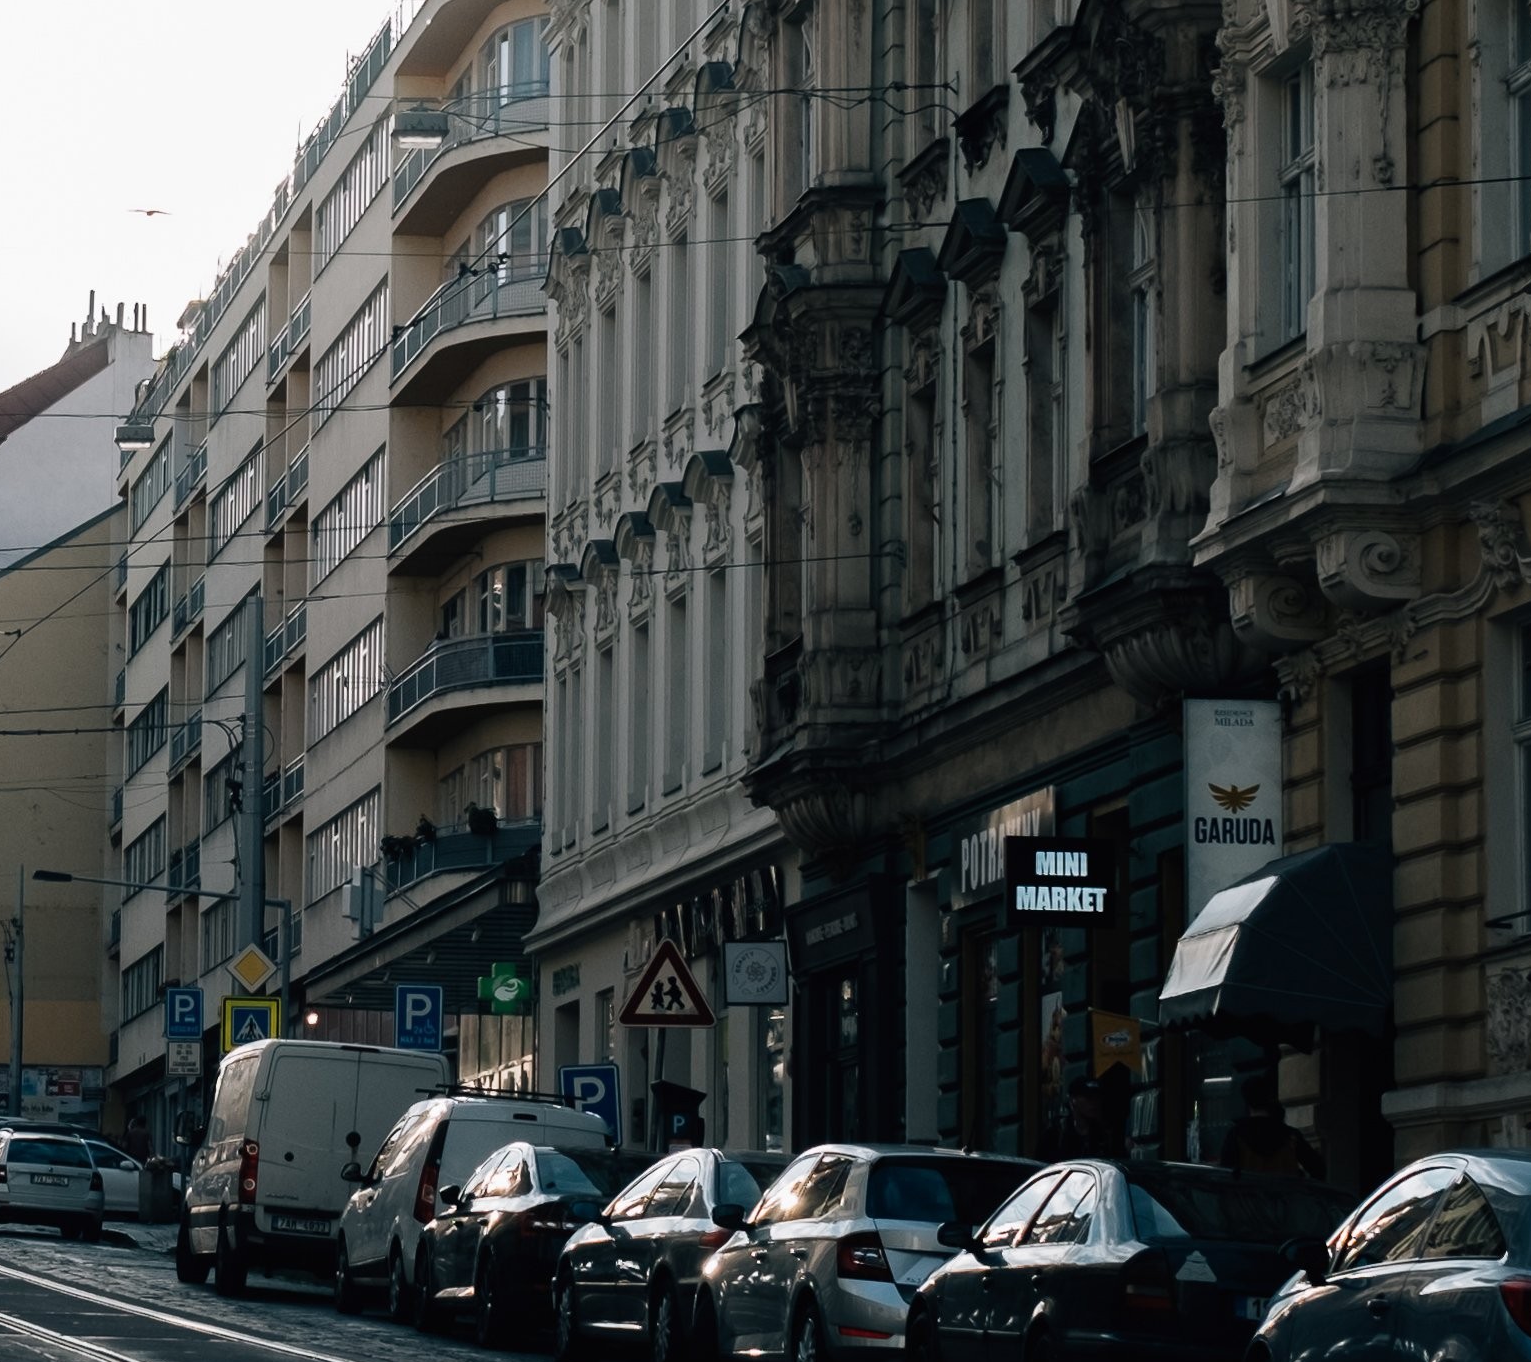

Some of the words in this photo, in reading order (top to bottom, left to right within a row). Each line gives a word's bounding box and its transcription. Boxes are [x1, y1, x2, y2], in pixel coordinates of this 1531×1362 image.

[1194, 817, 1275, 845] GARUDA
[1035, 850, 1089, 878] MINI
[1016, 885, 1108, 913] MARKET
[175, 994, 195, 1023] P
[405, 993, 432, 1030] P
[673, 1114, 685, 1134] P
